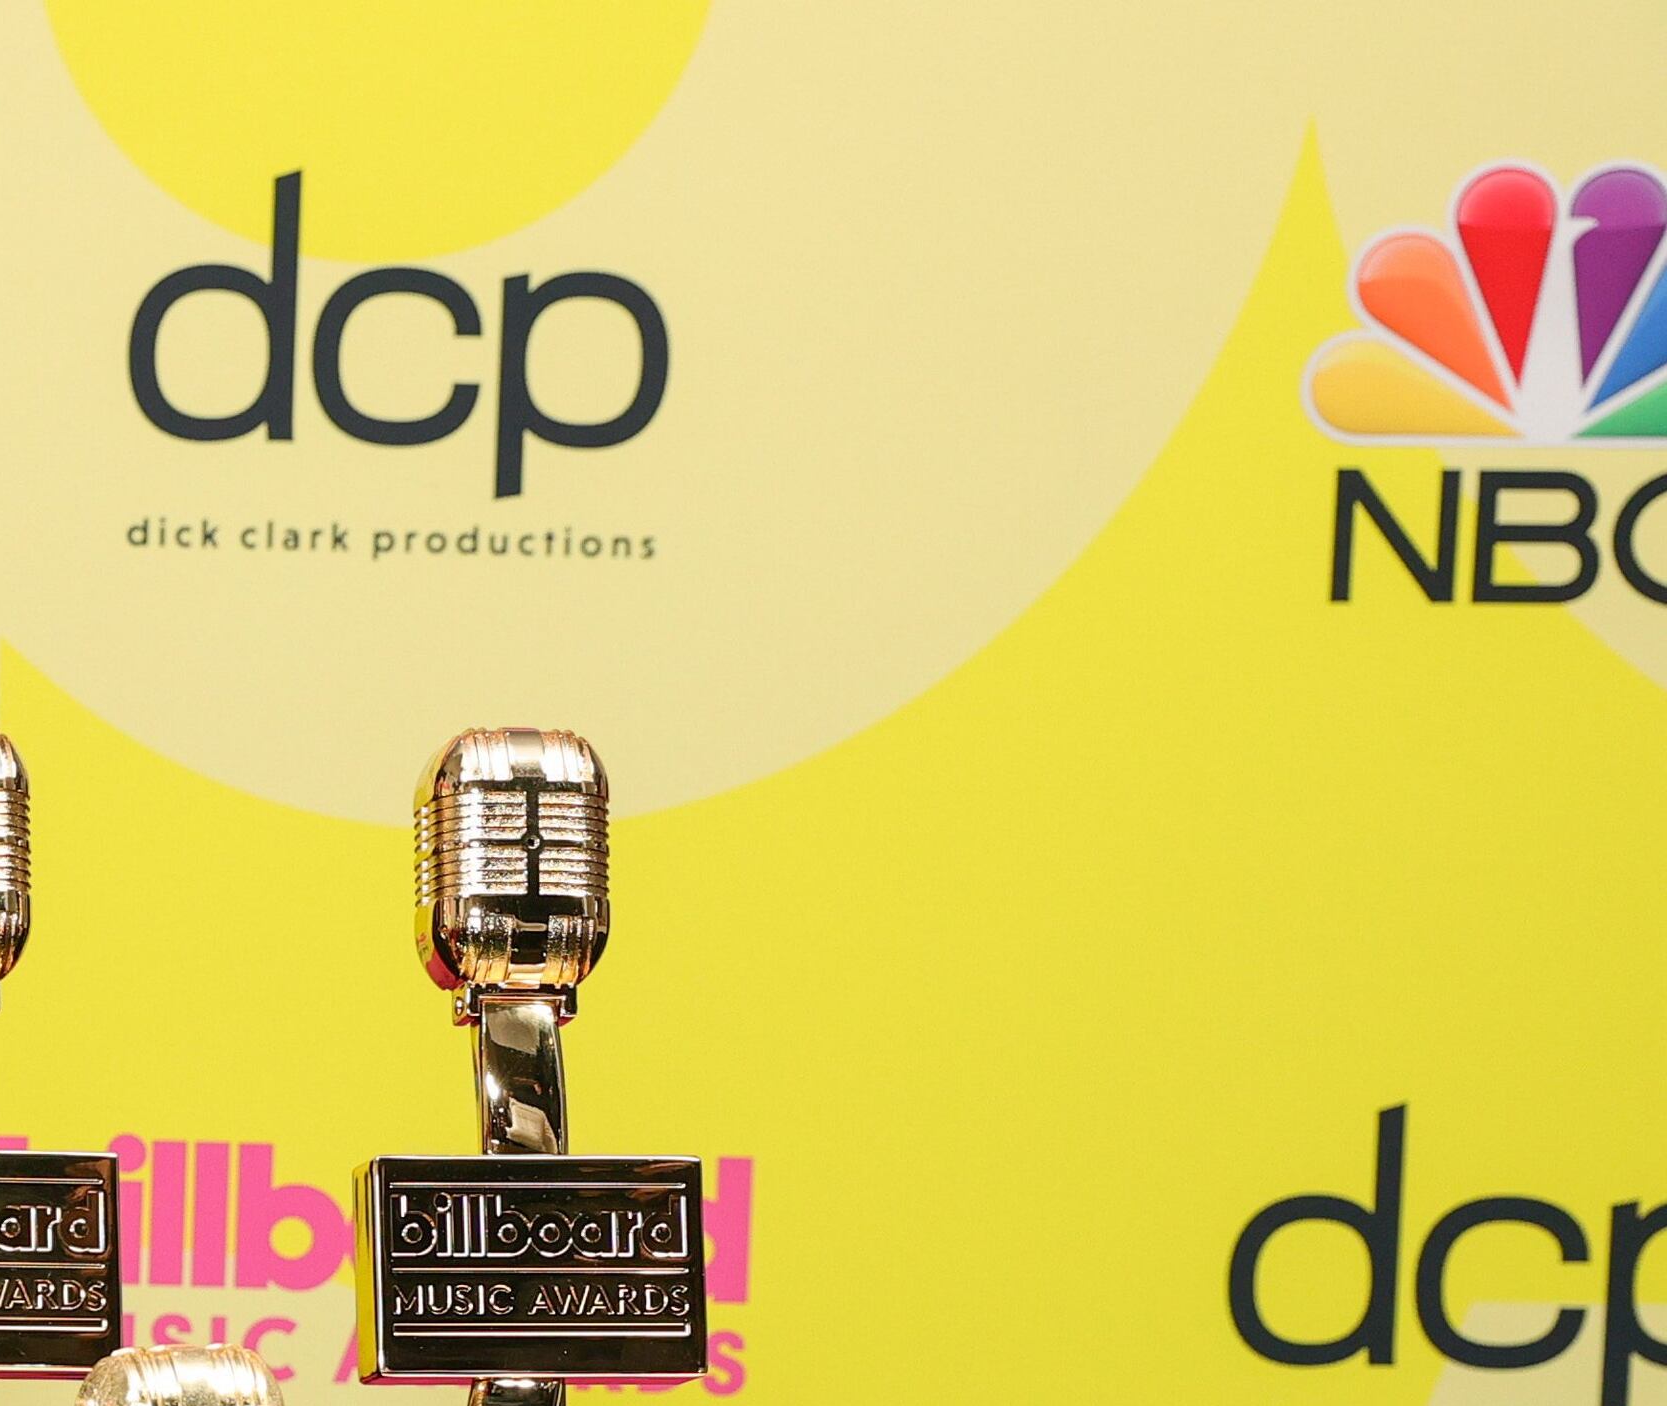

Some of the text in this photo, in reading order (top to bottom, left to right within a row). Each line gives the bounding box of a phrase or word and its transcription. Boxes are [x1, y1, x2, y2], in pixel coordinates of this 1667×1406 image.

[127, 168, 670, 500] dcp
[126, 517, 658, 561] dick clark productions
[389, 1191, 690, 1259] billboard
[391, 1283, 691, 1317] MUSIC AWARDS
